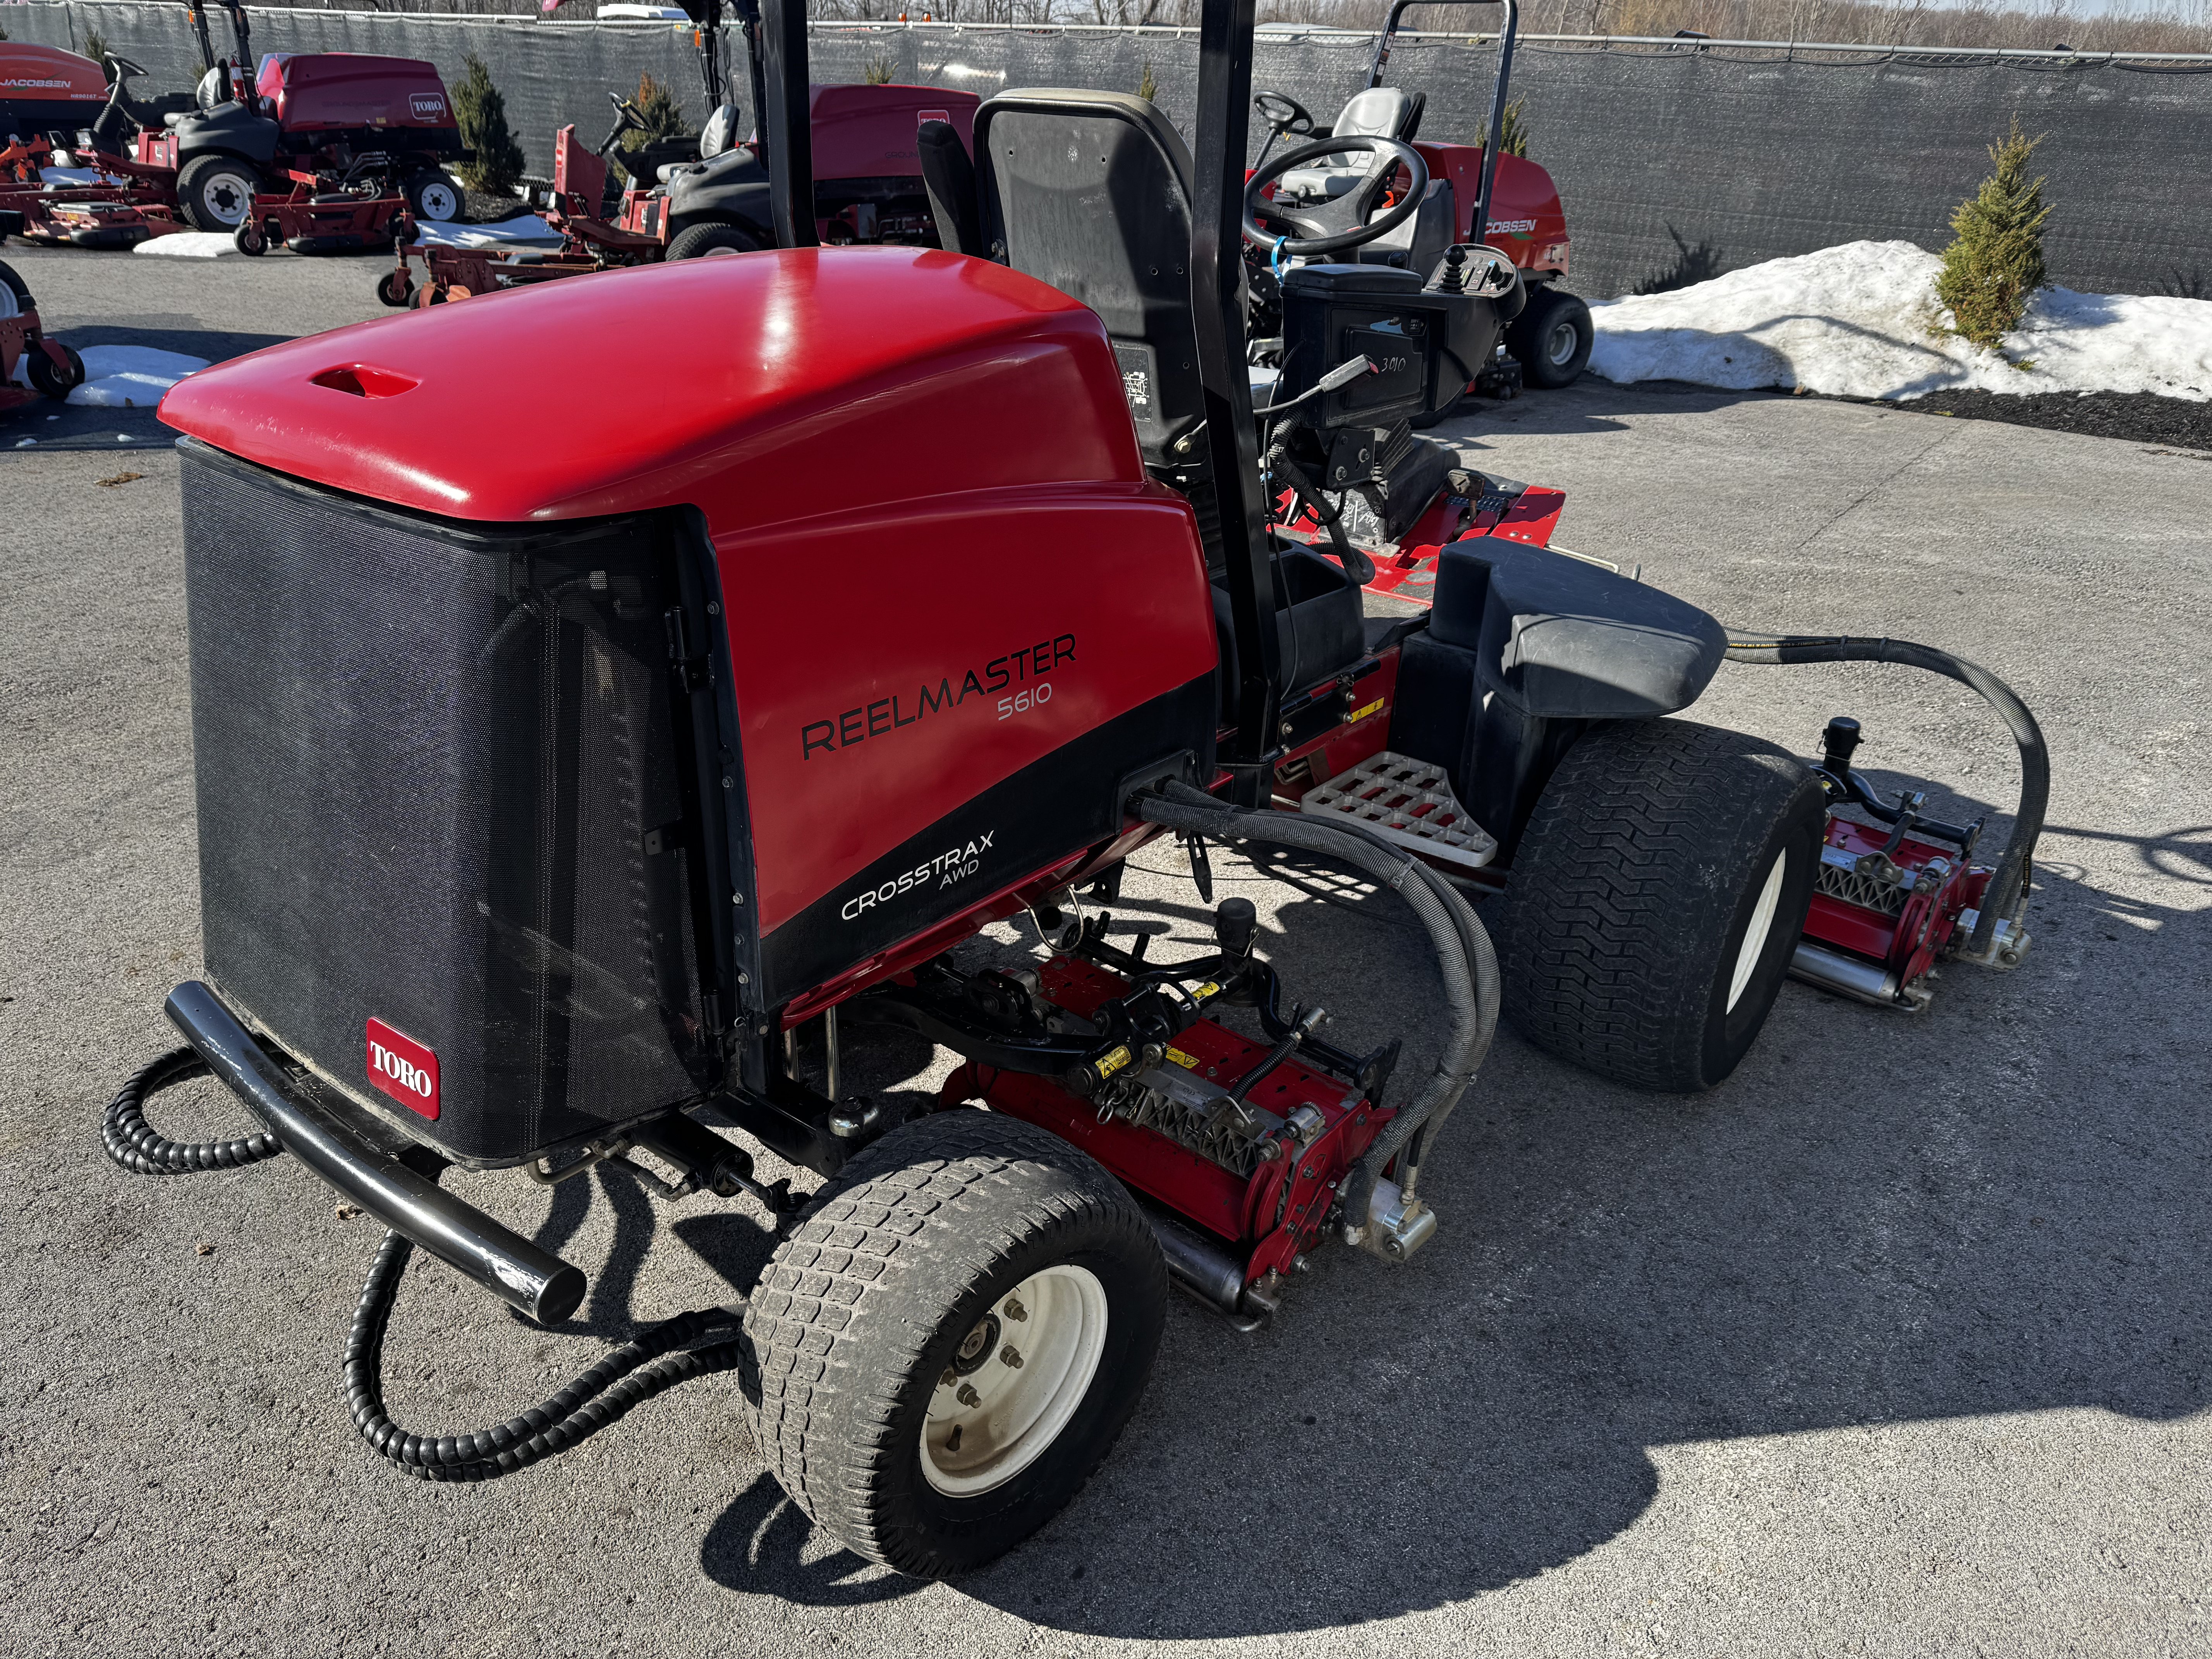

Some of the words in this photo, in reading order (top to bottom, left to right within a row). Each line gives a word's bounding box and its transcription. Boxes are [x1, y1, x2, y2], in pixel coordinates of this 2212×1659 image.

[0, 79, 71, 88] JACOBSEN
[413, 101, 442, 112] TORO
[1463, 219, 1536, 236] JCOBSEN
[801, 633, 1077, 761] REELMASTER
[997, 683, 1052, 721] 5610
[842, 830, 994, 921] CROSSTRAX
[939, 859, 979, 890] AWD
[370, 1040, 432, 1097] TORO
